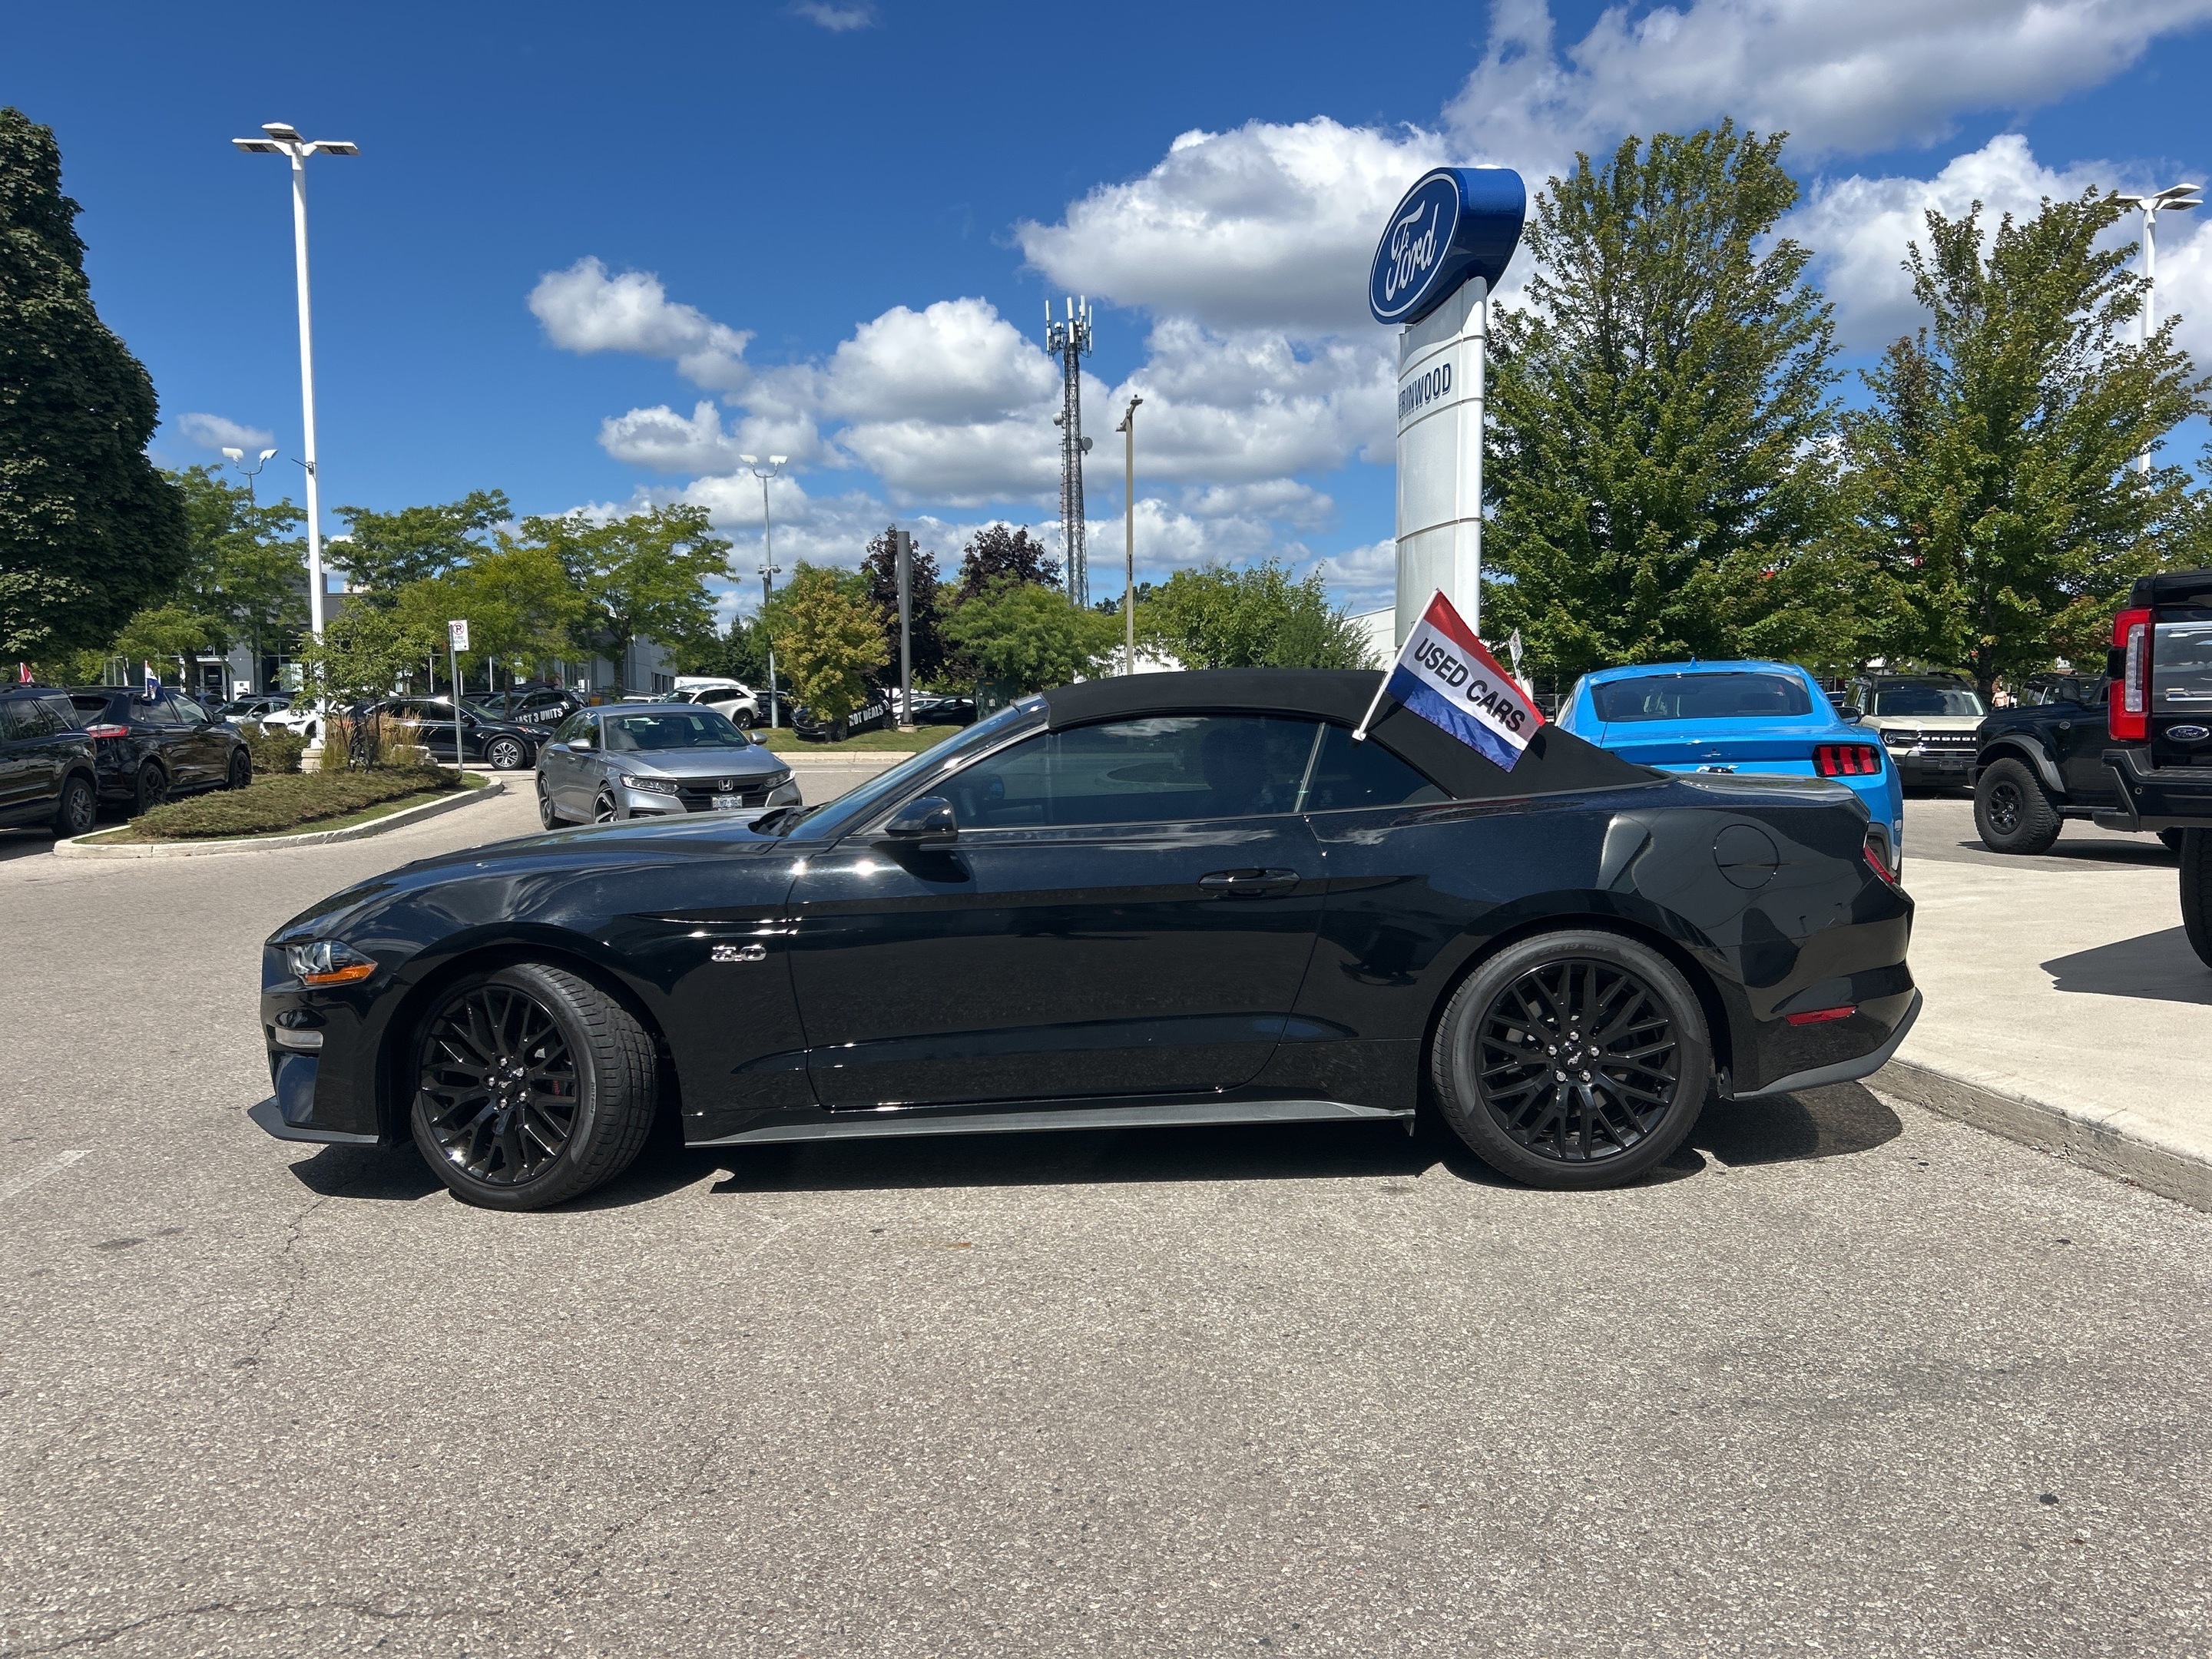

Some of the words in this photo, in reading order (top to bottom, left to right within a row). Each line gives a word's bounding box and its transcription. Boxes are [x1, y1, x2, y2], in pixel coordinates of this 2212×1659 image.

[1386, 200, 1440, 302] Ford
[1398, 363, 1451, 421] ERINWOOD
[863, 704, 884, 721] DEALS
[1414, 637, 1469, 687] USED
[1465, 680, 1525, 732] CARS
[533, 713, 539, 723] 3
